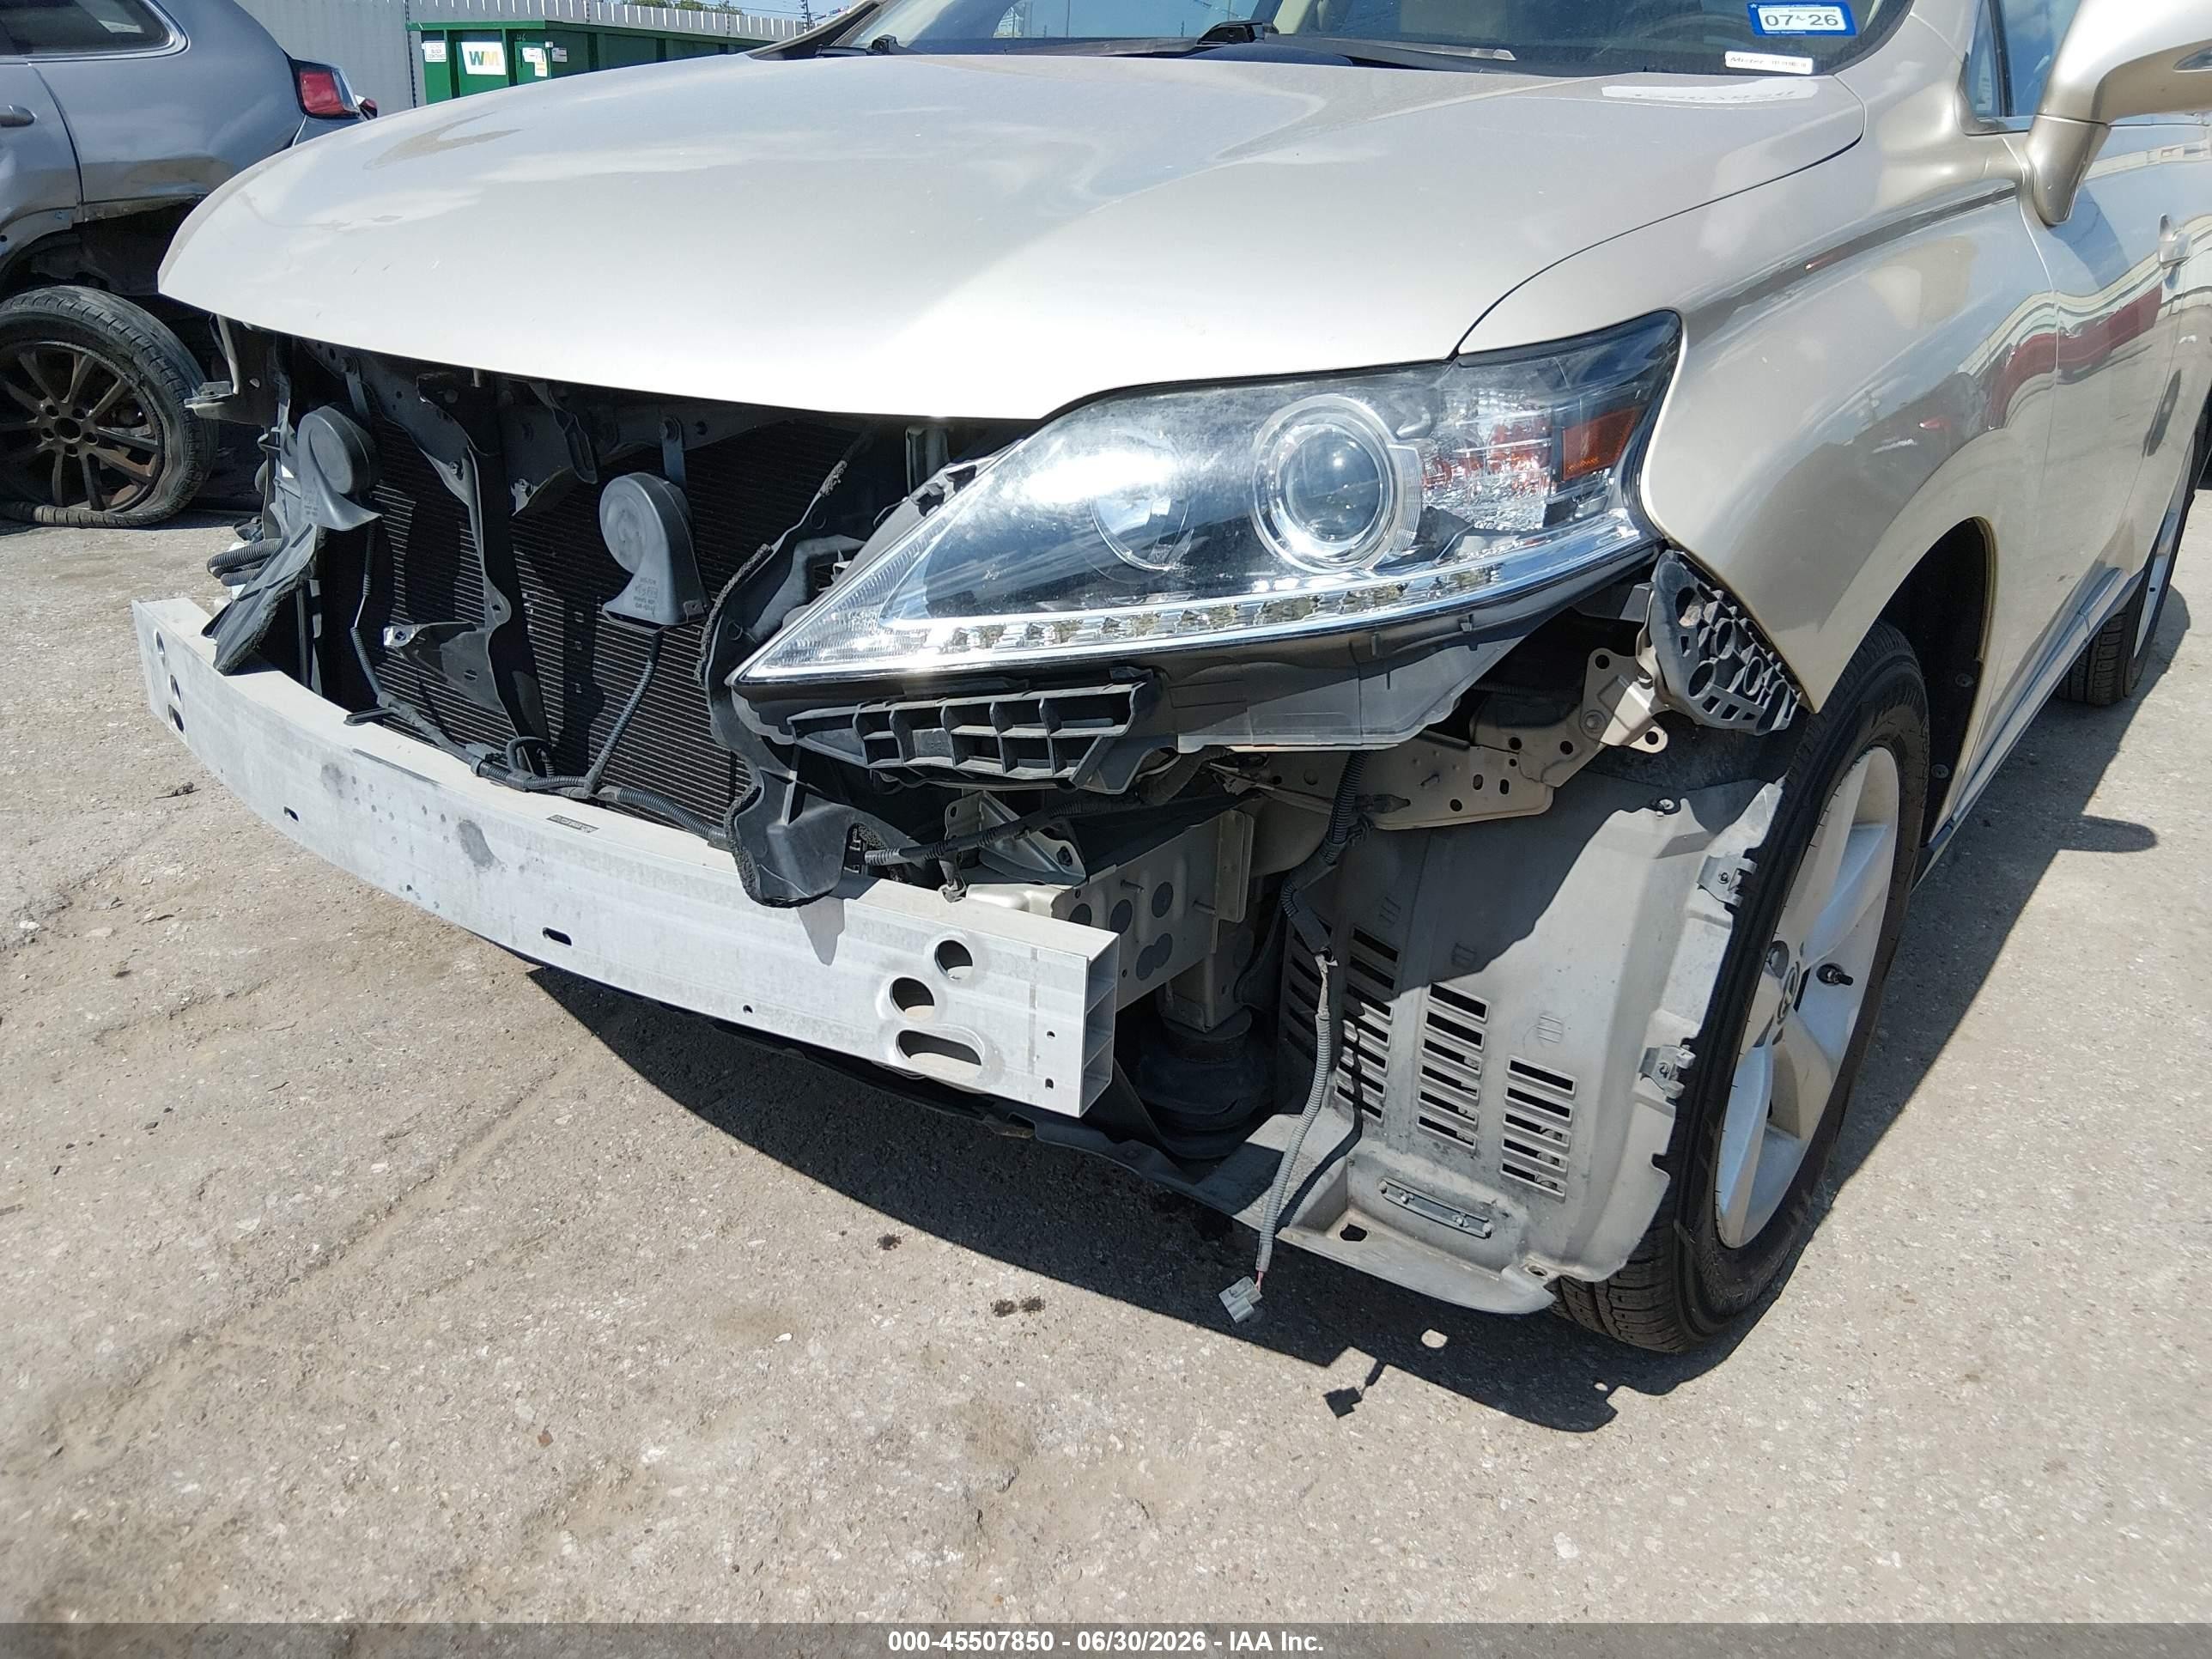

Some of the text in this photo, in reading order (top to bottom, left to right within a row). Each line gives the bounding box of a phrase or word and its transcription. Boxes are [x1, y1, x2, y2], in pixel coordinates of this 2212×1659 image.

[1765, 14, 1838, 26] 07 26
[468, 51, 500, 65] WM
